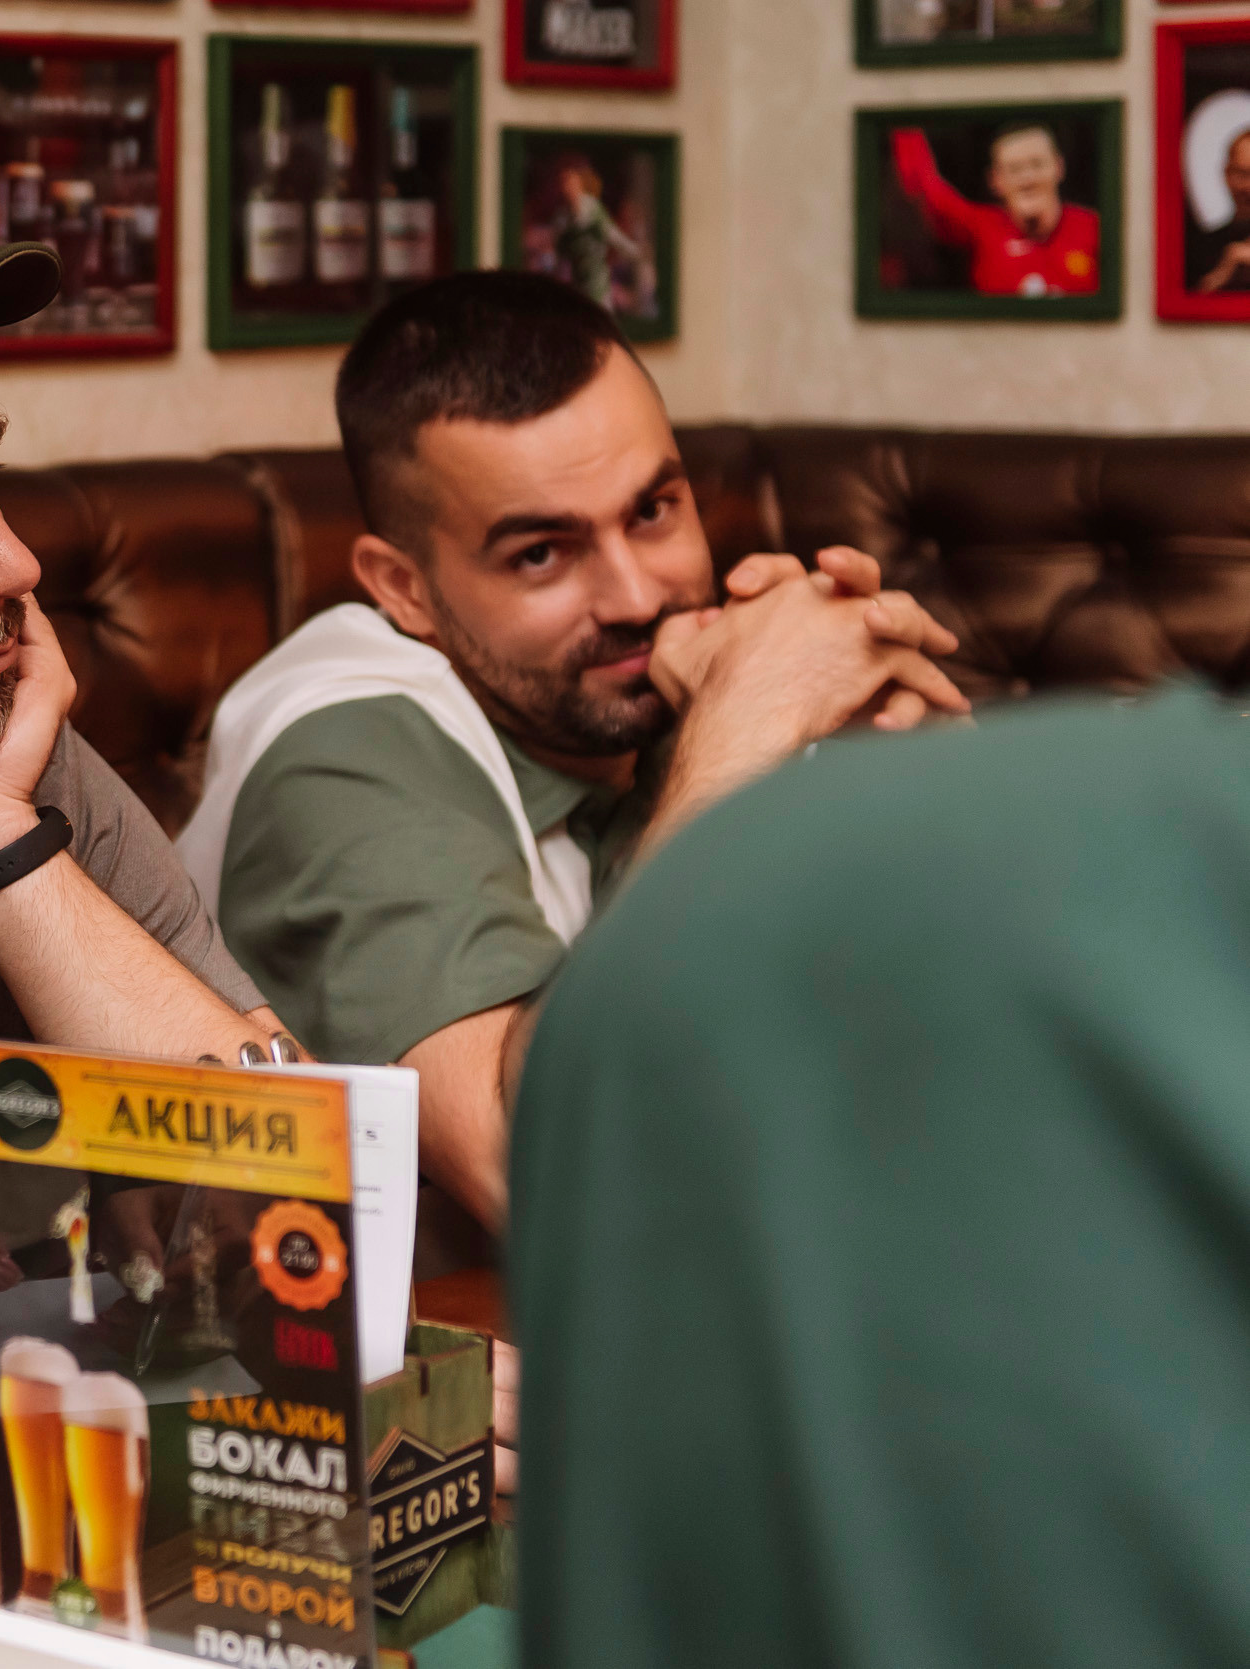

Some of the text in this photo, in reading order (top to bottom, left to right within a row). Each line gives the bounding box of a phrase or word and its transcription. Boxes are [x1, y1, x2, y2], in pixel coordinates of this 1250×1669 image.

[108, 1094, 299, 1158] АКЦИЯ
[187, 1387, 347, 1446] ЗАКАЖИ
[187, 1425, 348, 1493] БОКАЛ
[188, 1470, 349, 1520] ФИРМЕННОГО
[192, 1564, 356, 1633] ВТОРОЙ
